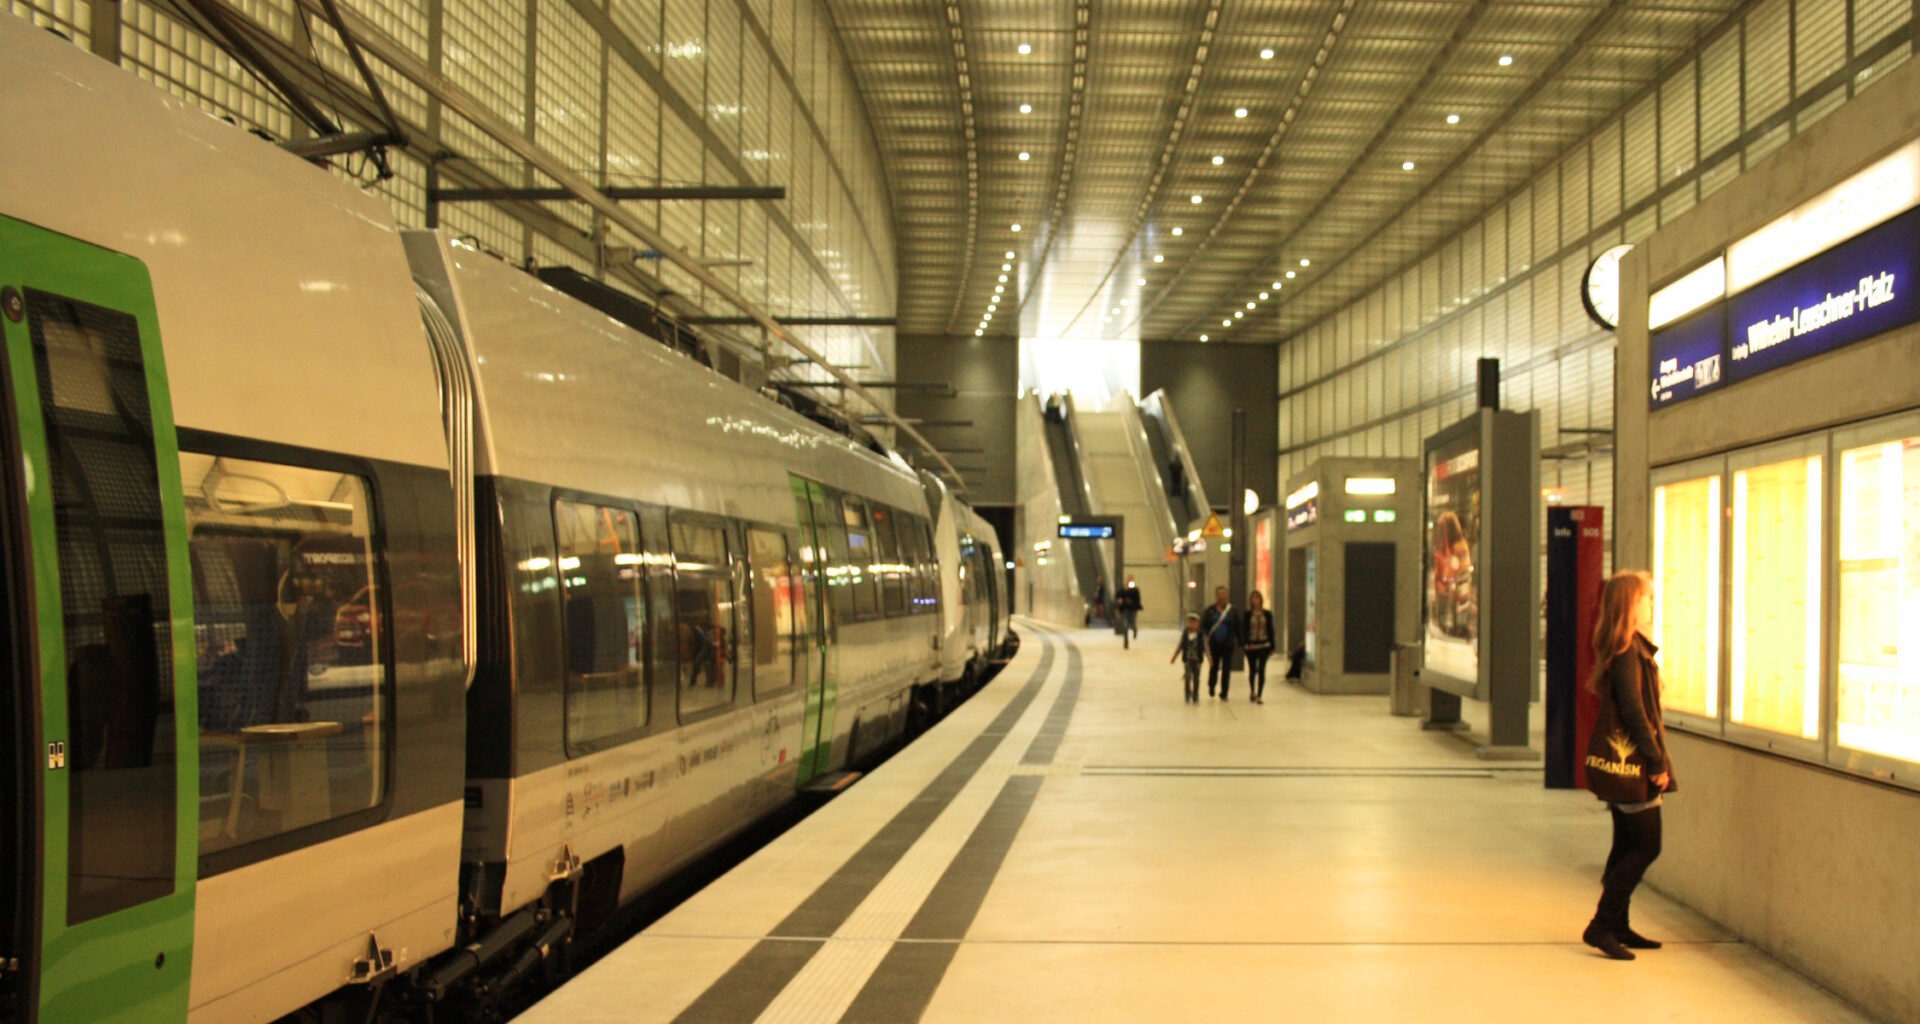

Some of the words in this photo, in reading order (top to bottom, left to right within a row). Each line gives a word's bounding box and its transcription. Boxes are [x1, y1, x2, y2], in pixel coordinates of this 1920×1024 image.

[1748, 271, 1895, 354] Wilhelm-Leuschner-Platz
[1555, 527, 1571, 537] Info
[1583, 528, 1599, 537] SOS
